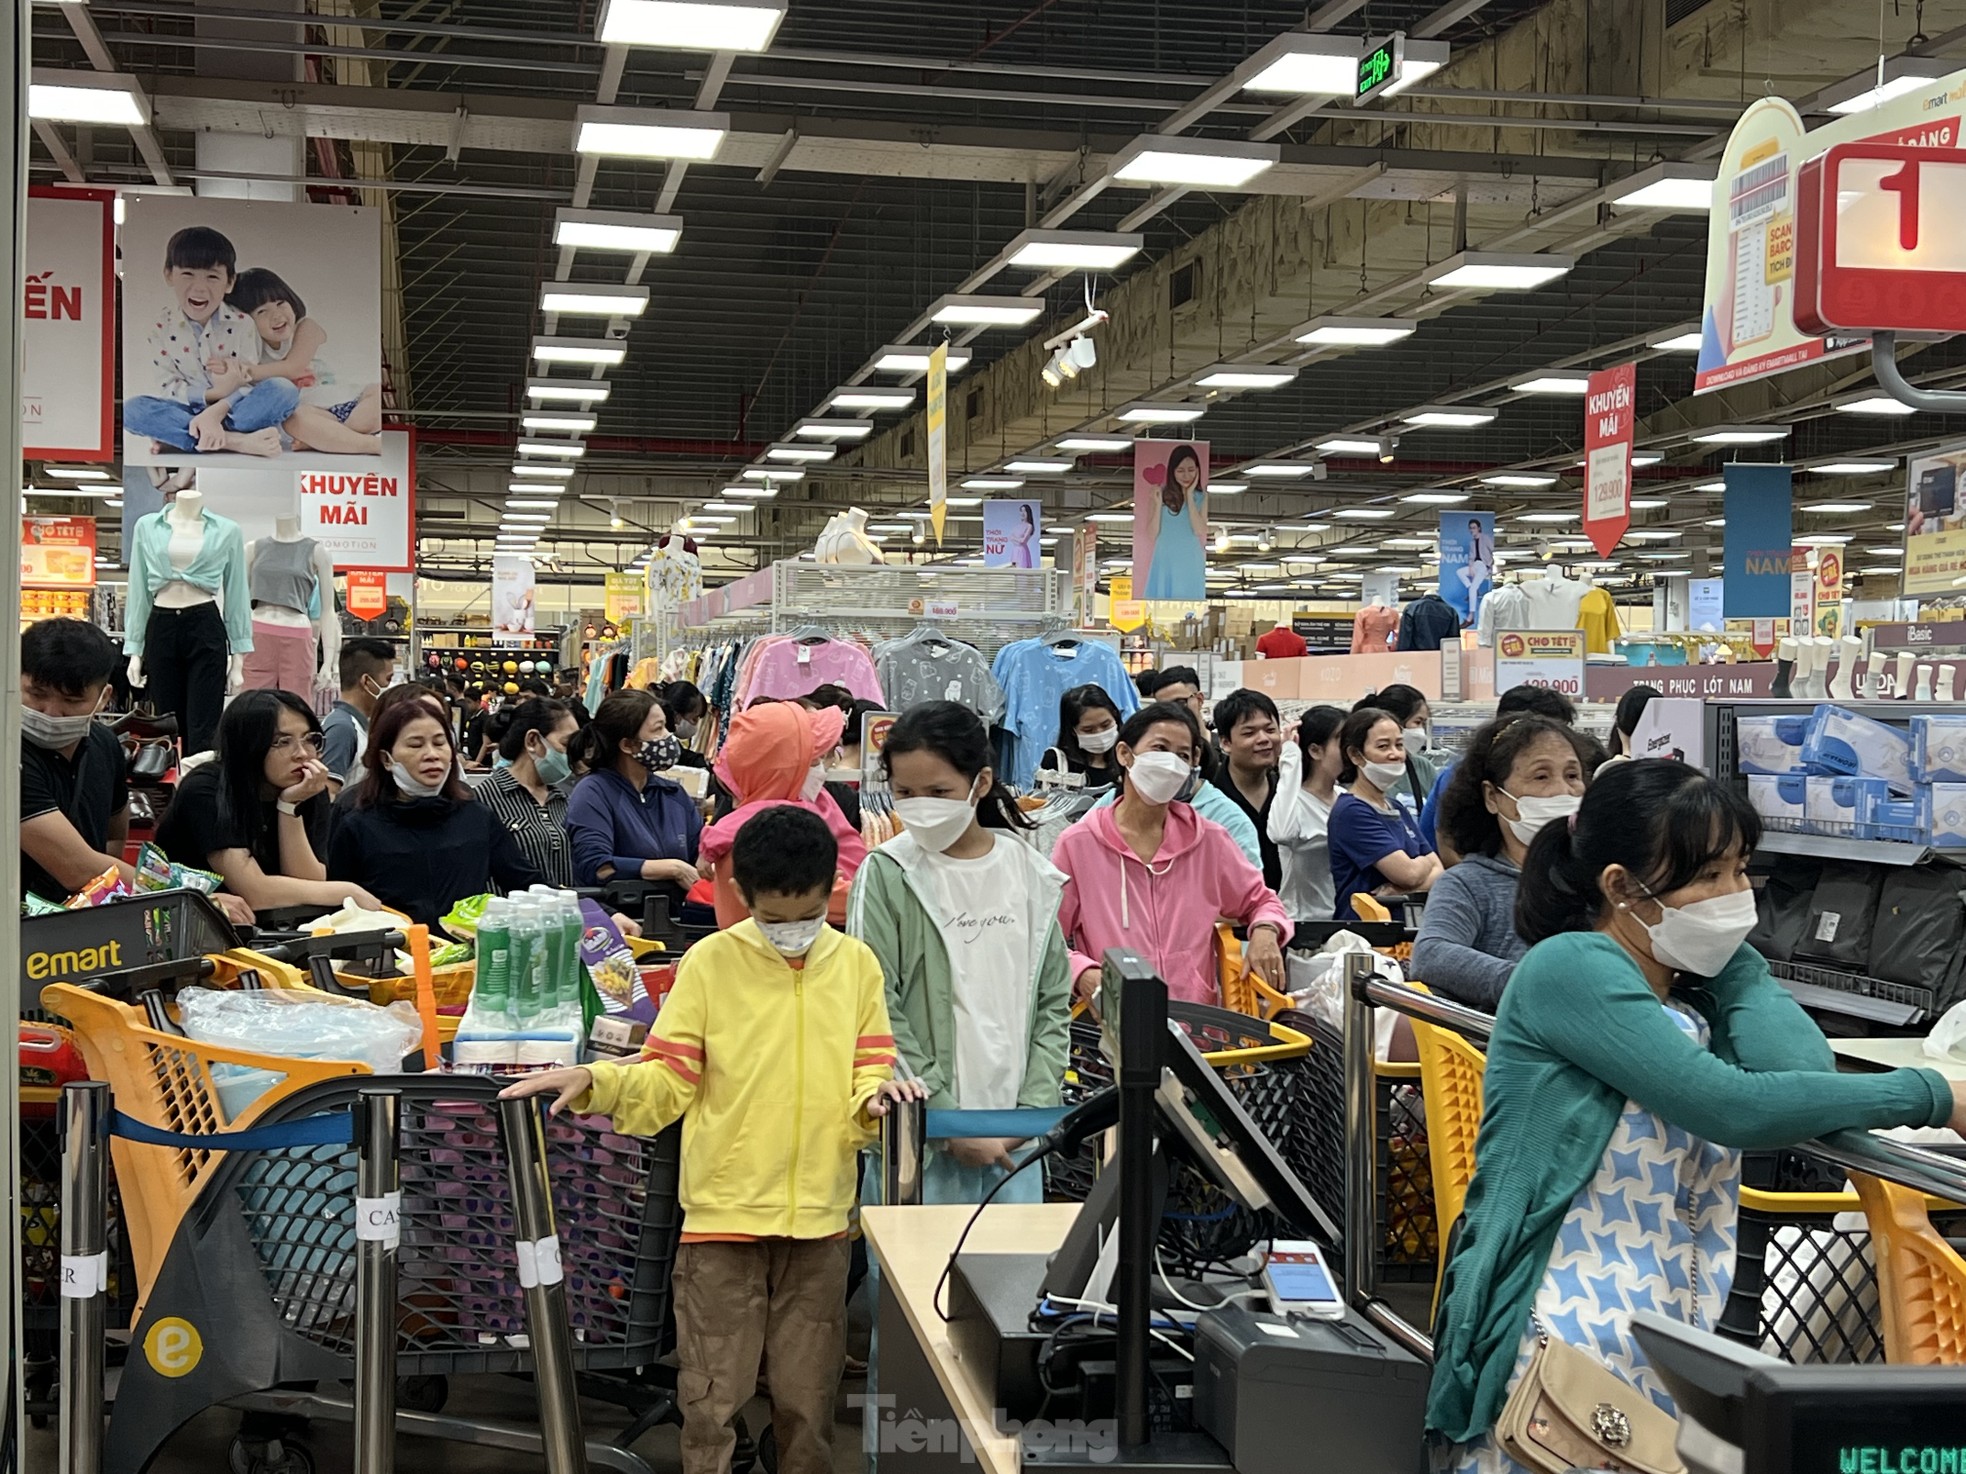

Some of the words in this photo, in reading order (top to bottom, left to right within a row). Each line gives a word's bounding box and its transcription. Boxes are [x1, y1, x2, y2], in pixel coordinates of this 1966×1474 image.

[1880, 160, 1919, 250] 1
[320, 501, 368, 525] MÃI
[1442, 554, 1470, 564] NAM
[1745, 557, 1792, 575] NAM
[1670, 679, 1696, 698] PHỤC
[1704, 674, 1724, 694] LÓT
[1730, 678, 1752, 694] NAM
[26, 940, 122, 980] emart
